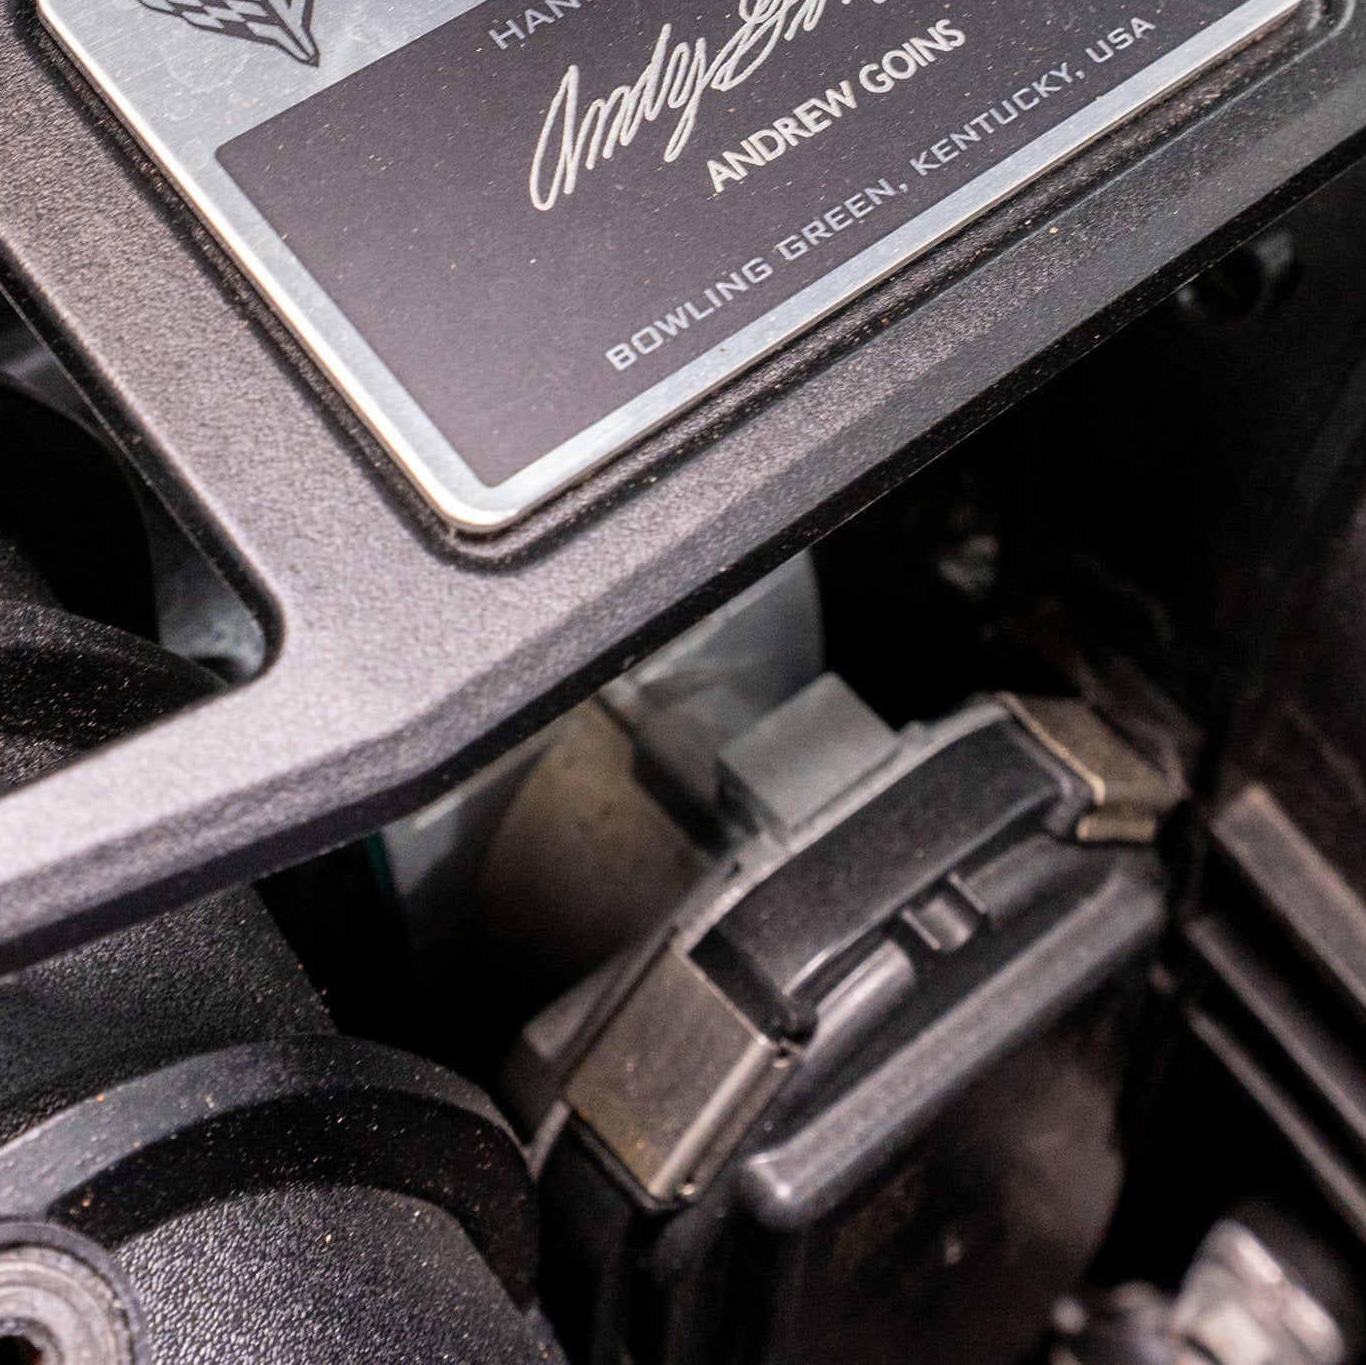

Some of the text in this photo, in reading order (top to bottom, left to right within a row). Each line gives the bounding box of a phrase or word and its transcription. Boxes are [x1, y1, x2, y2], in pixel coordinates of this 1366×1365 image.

[604, 16, 1156, 373] BOWLING GREEN, KENTUCKY, USA
[705, 17, 966, 193] ANDREW GOINS
